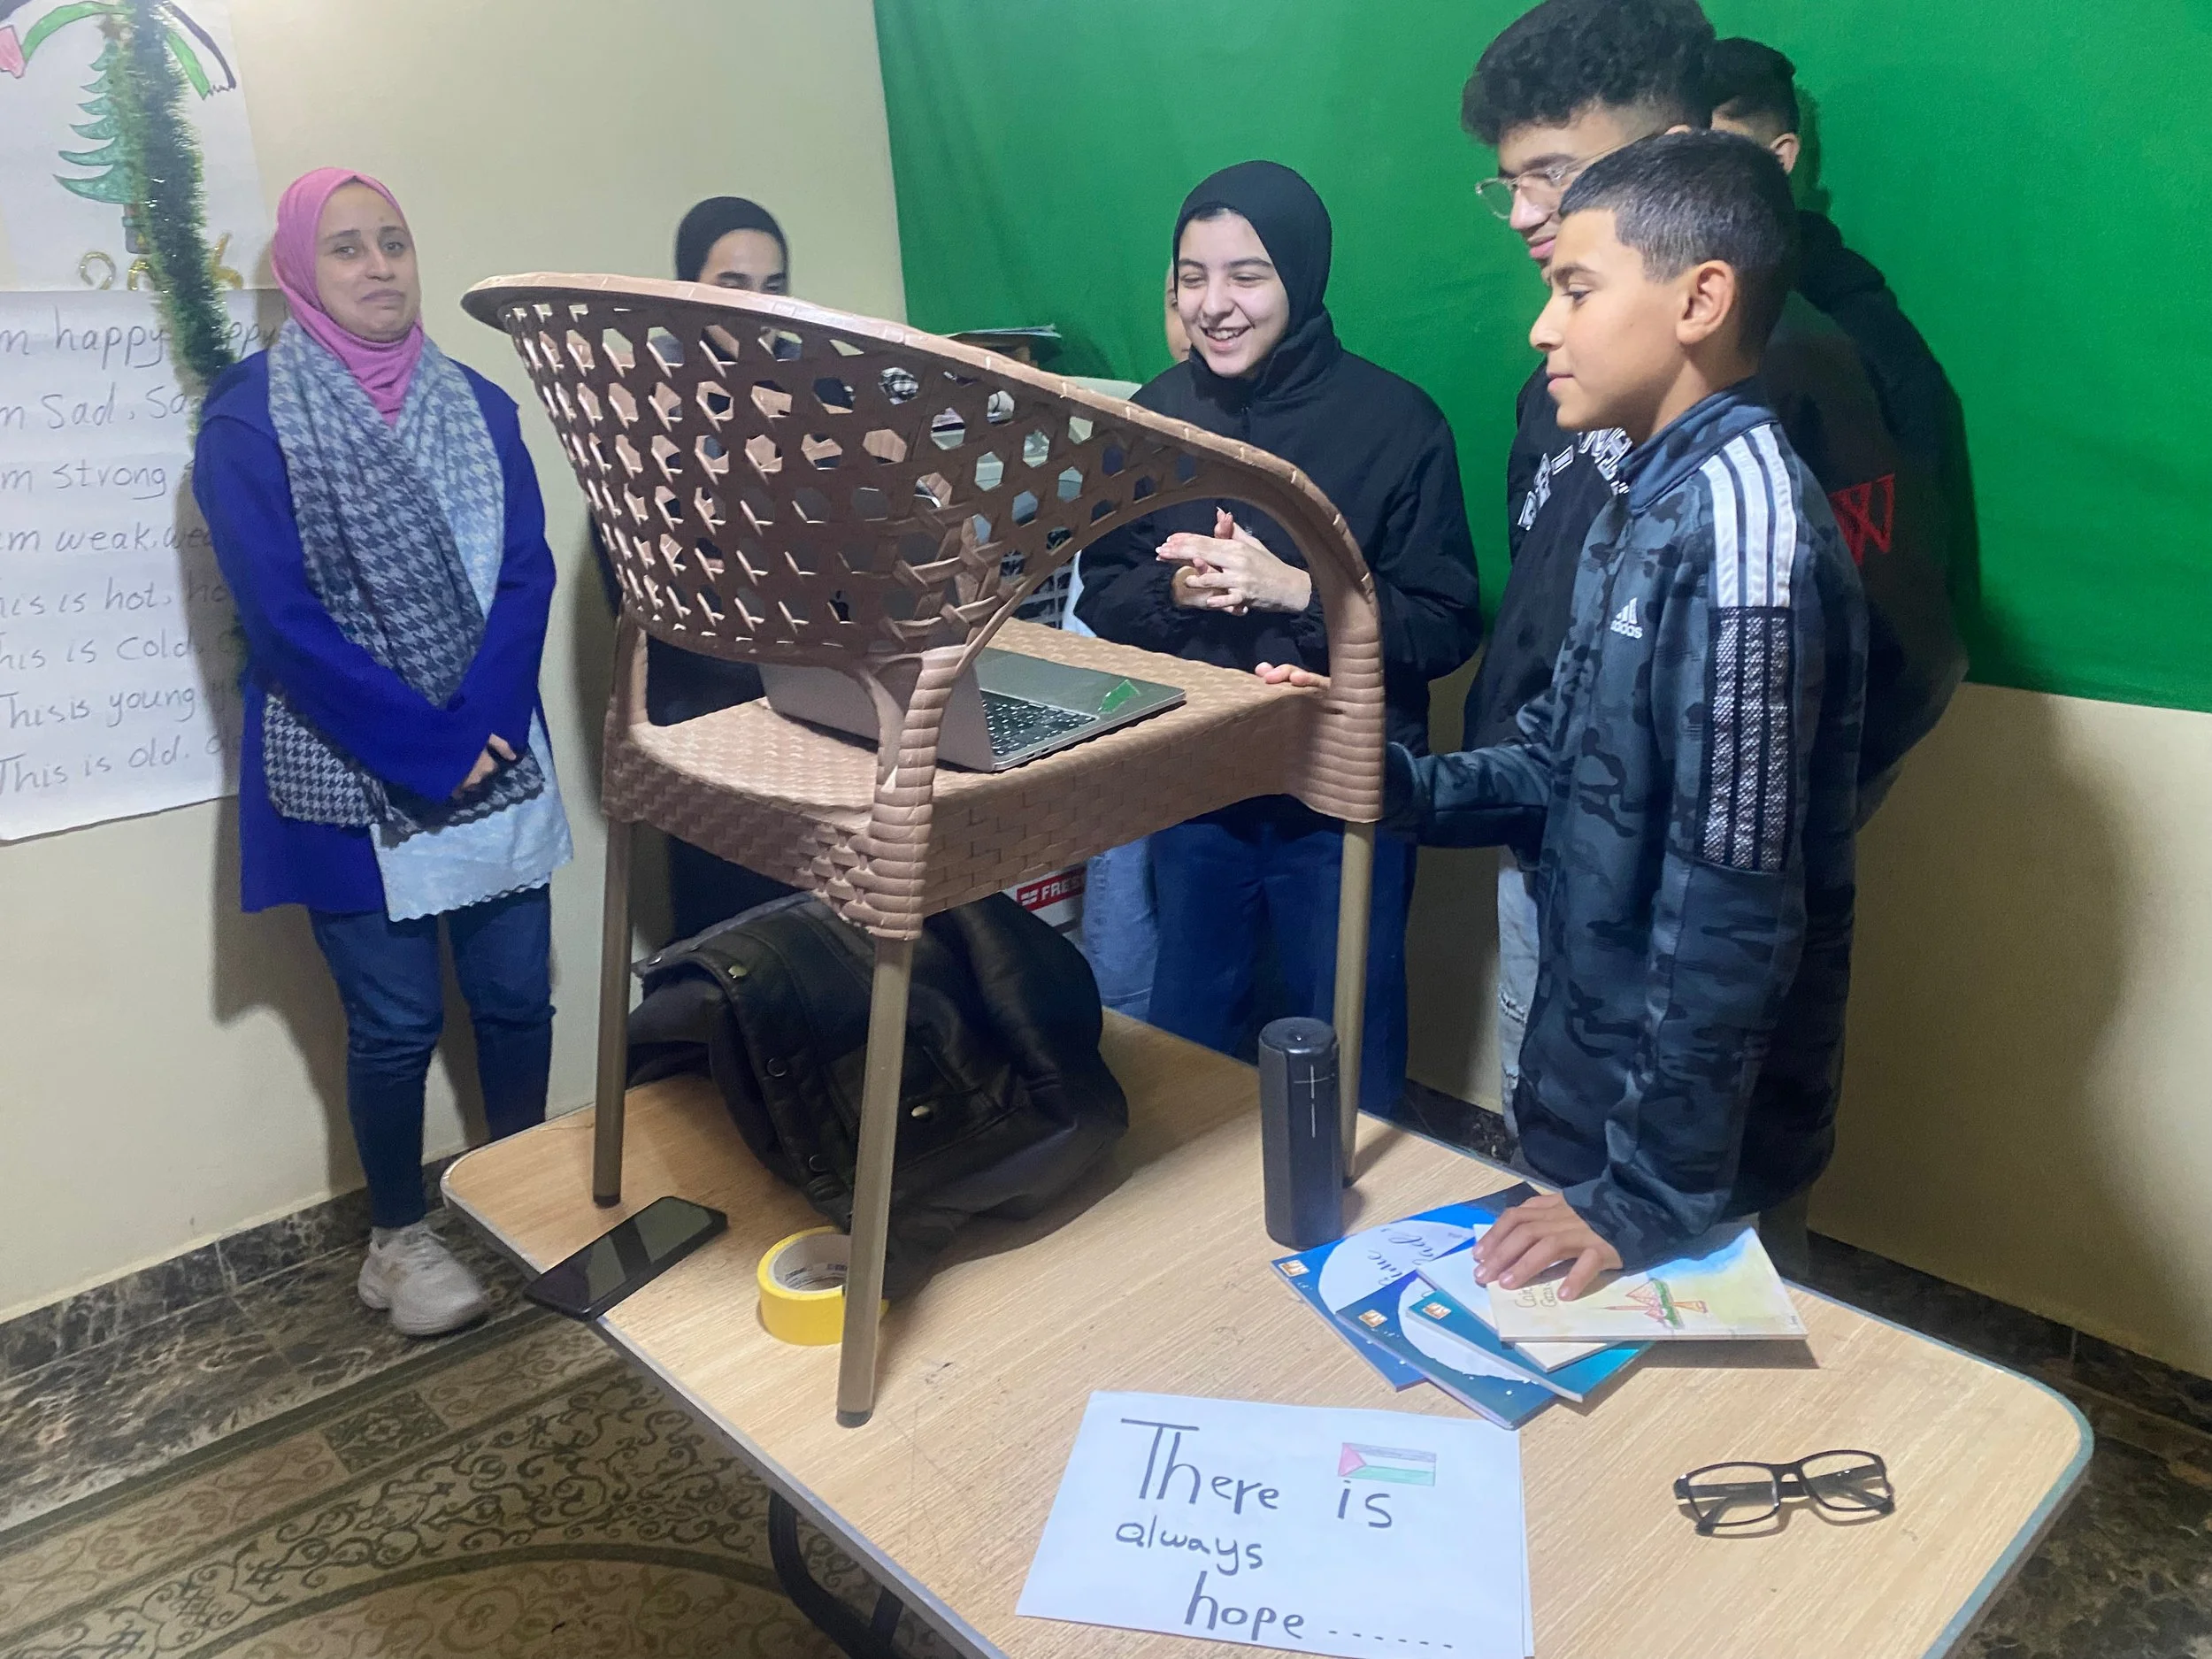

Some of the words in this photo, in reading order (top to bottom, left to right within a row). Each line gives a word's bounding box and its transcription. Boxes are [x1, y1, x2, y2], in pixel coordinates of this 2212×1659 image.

[58, 592, 88, 613] is
[66, 638, 97, 664] is
[84, 755, 111, 777] is
[1120, 1417, 1280, 1515] There
[1336, 1479, 1394, 1529] is
[1115, 1514, 1263, 1575] always
